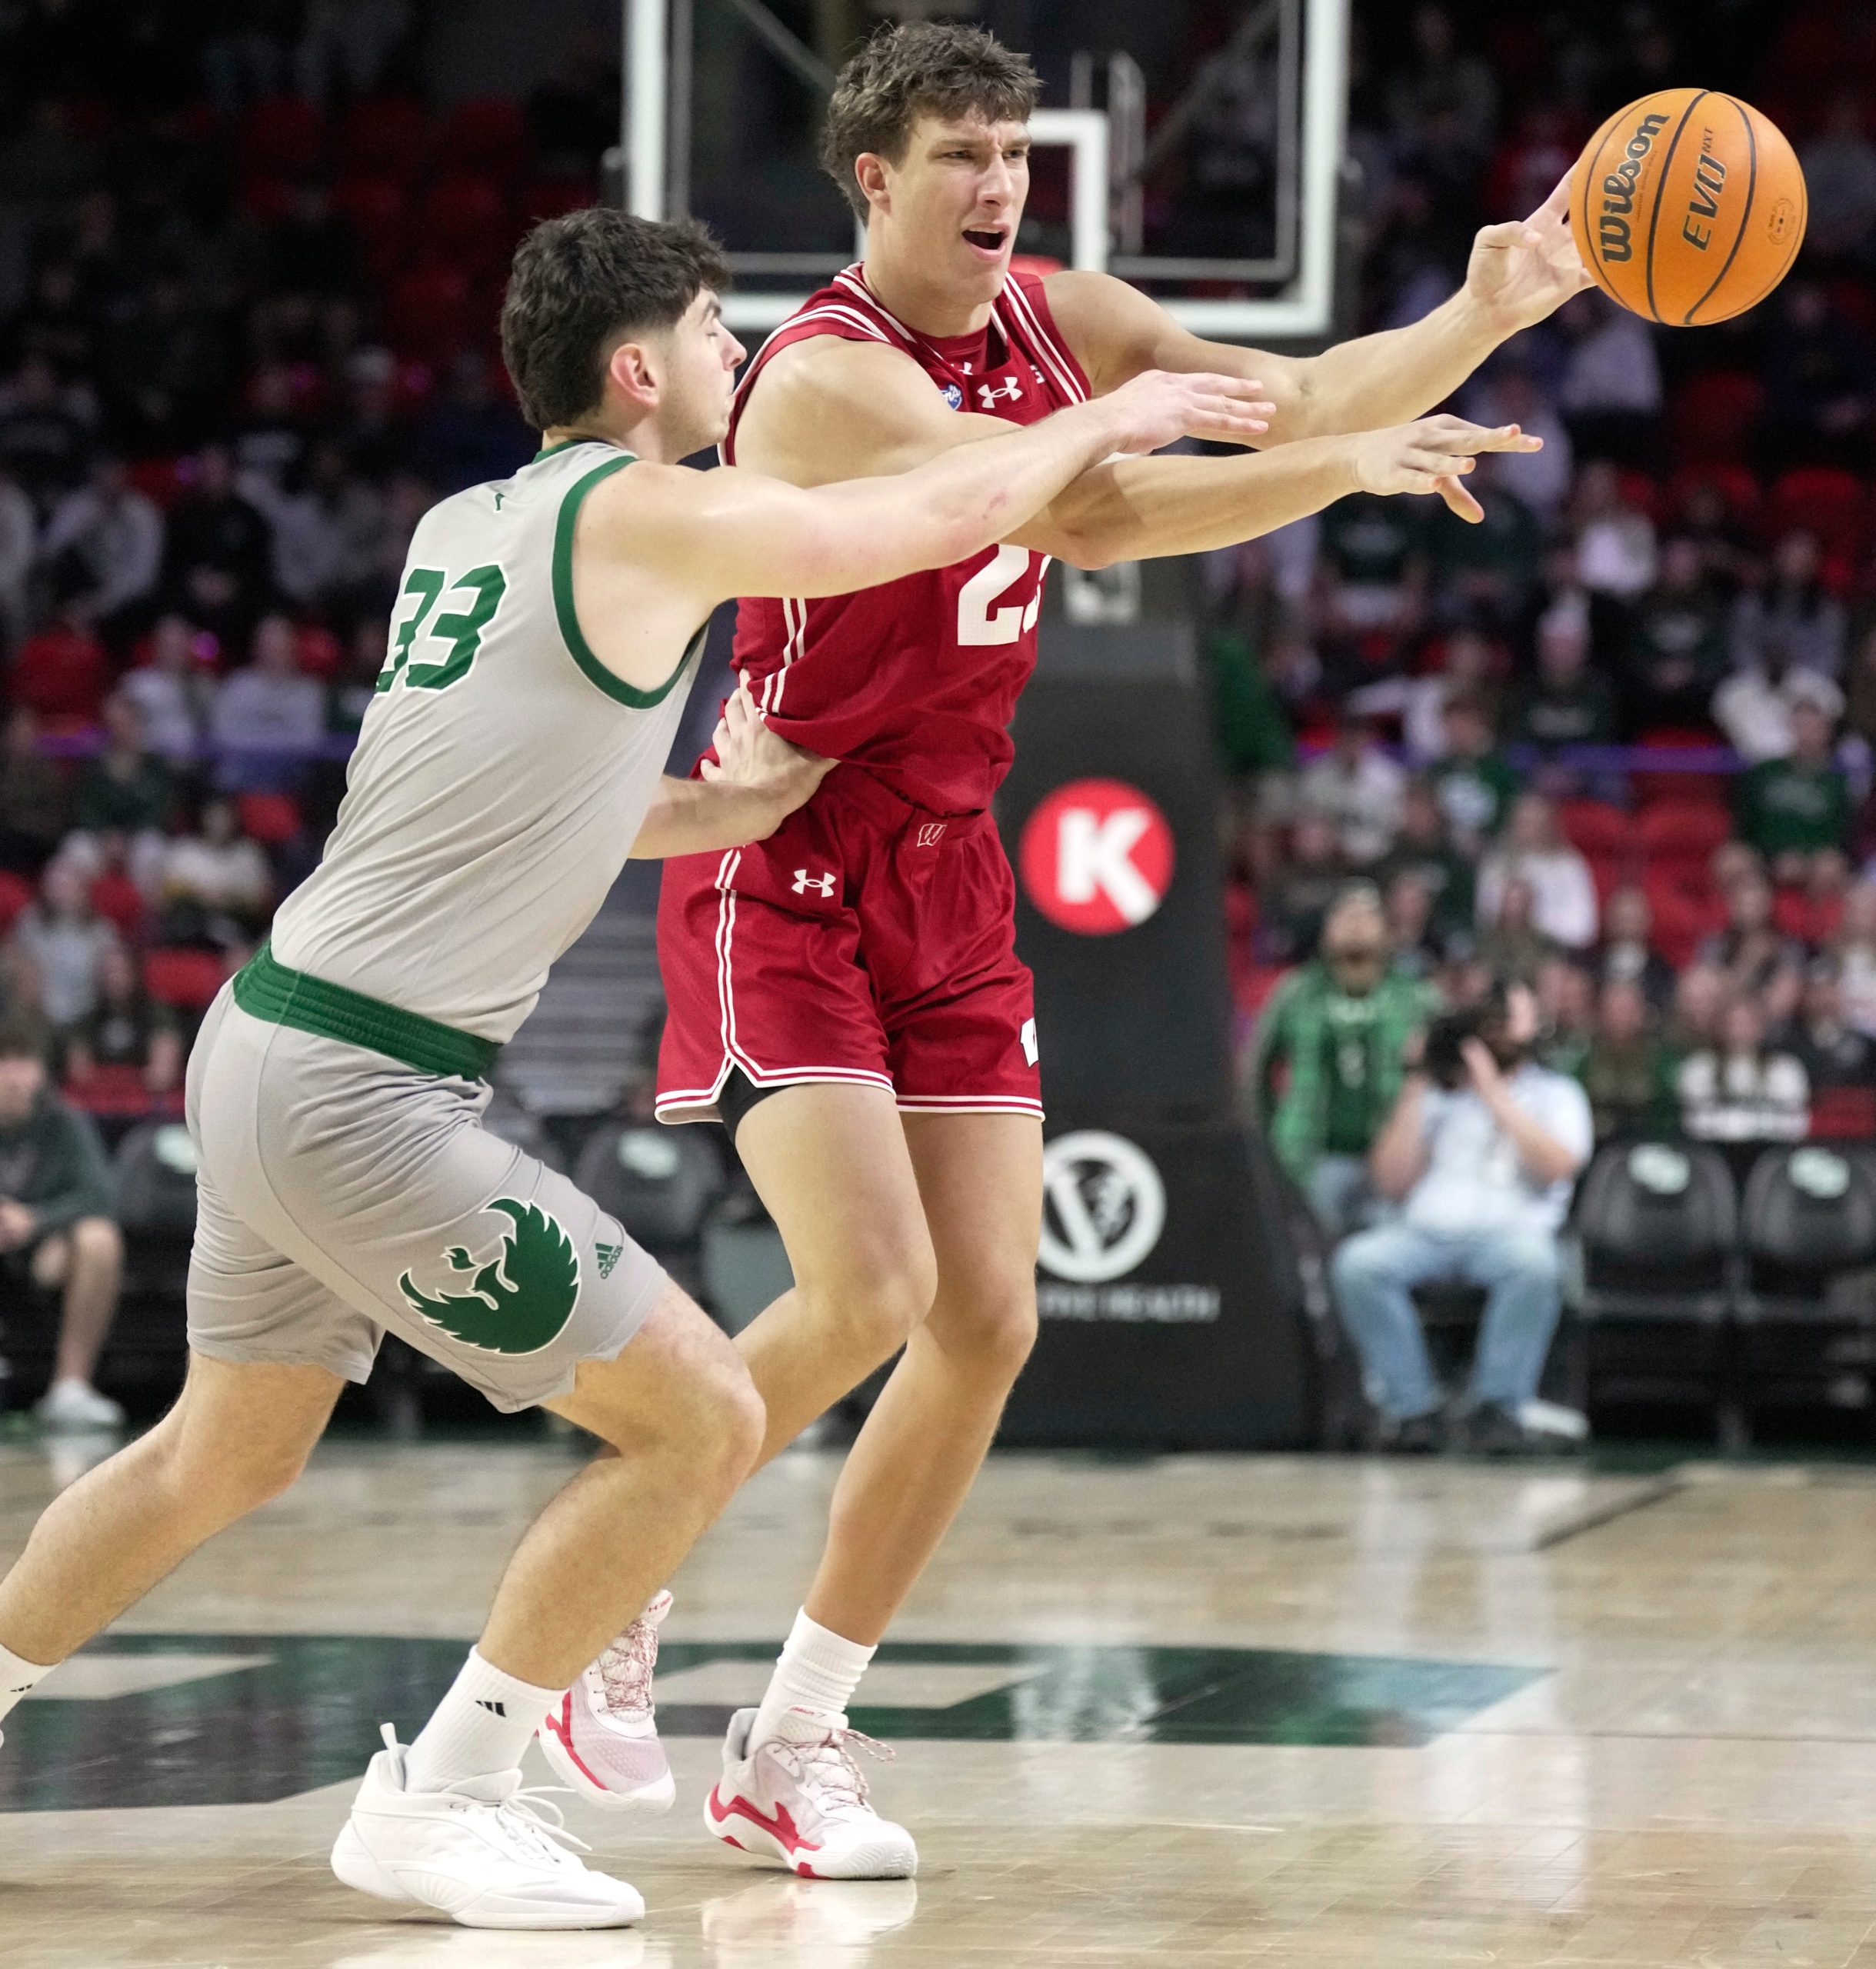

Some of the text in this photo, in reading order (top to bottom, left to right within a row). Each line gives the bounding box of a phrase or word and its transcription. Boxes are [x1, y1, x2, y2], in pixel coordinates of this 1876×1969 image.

[1599, 115, 1671, 262] Wilson
[1702, 127, 1714, 154] NXT
[374, 561, 510, 697] 33
[1058, 808, 1158, 925] K
[600, 1245, 624, 1279] adidas
